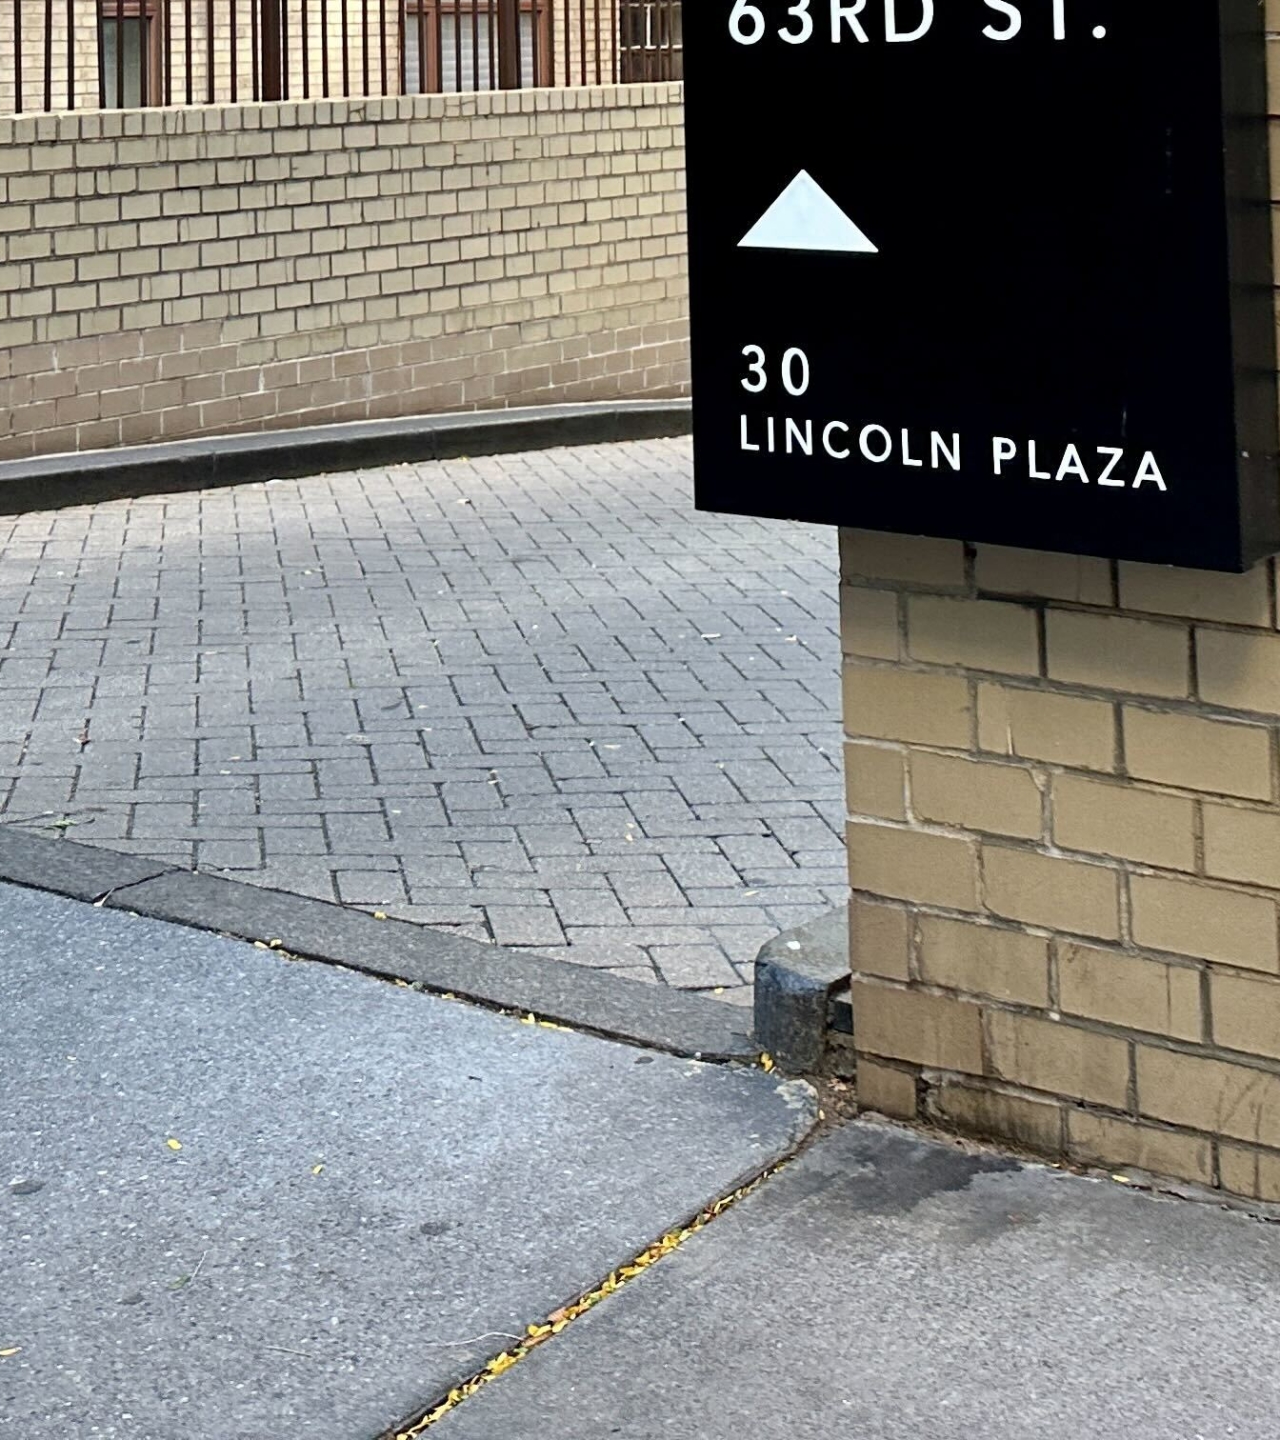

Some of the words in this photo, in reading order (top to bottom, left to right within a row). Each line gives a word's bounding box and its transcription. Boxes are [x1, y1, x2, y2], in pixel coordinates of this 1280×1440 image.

[739, 343, 811, 396] 30
[739, 413, 962, 471] LINCOLN
[991, 435, 1169, 492] PLAZA
